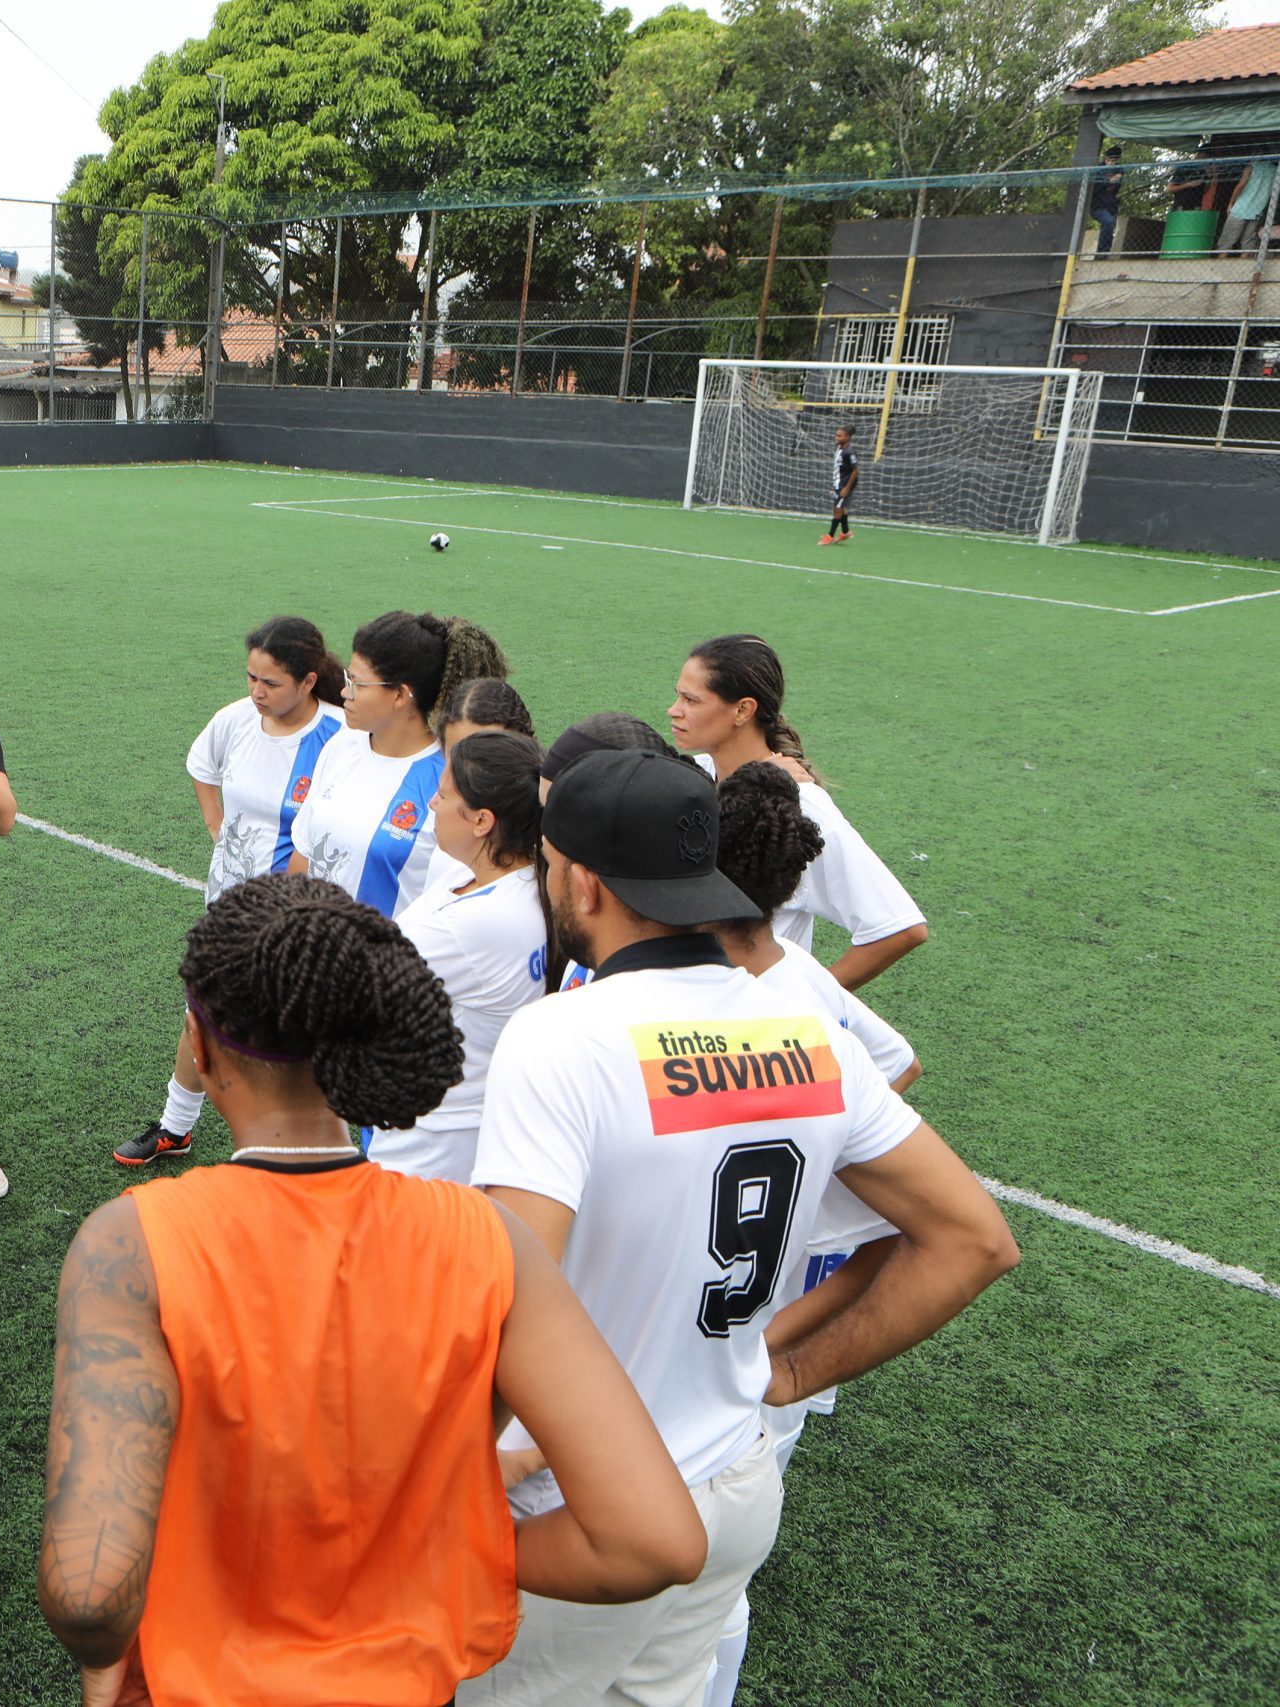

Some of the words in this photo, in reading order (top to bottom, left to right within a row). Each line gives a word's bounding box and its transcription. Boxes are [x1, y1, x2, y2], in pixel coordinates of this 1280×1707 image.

[657, 1030, 728, 1056] tintas
[662, 1038, 817, 1097] suvinil
[696, 1138, 806, 1339] 9
